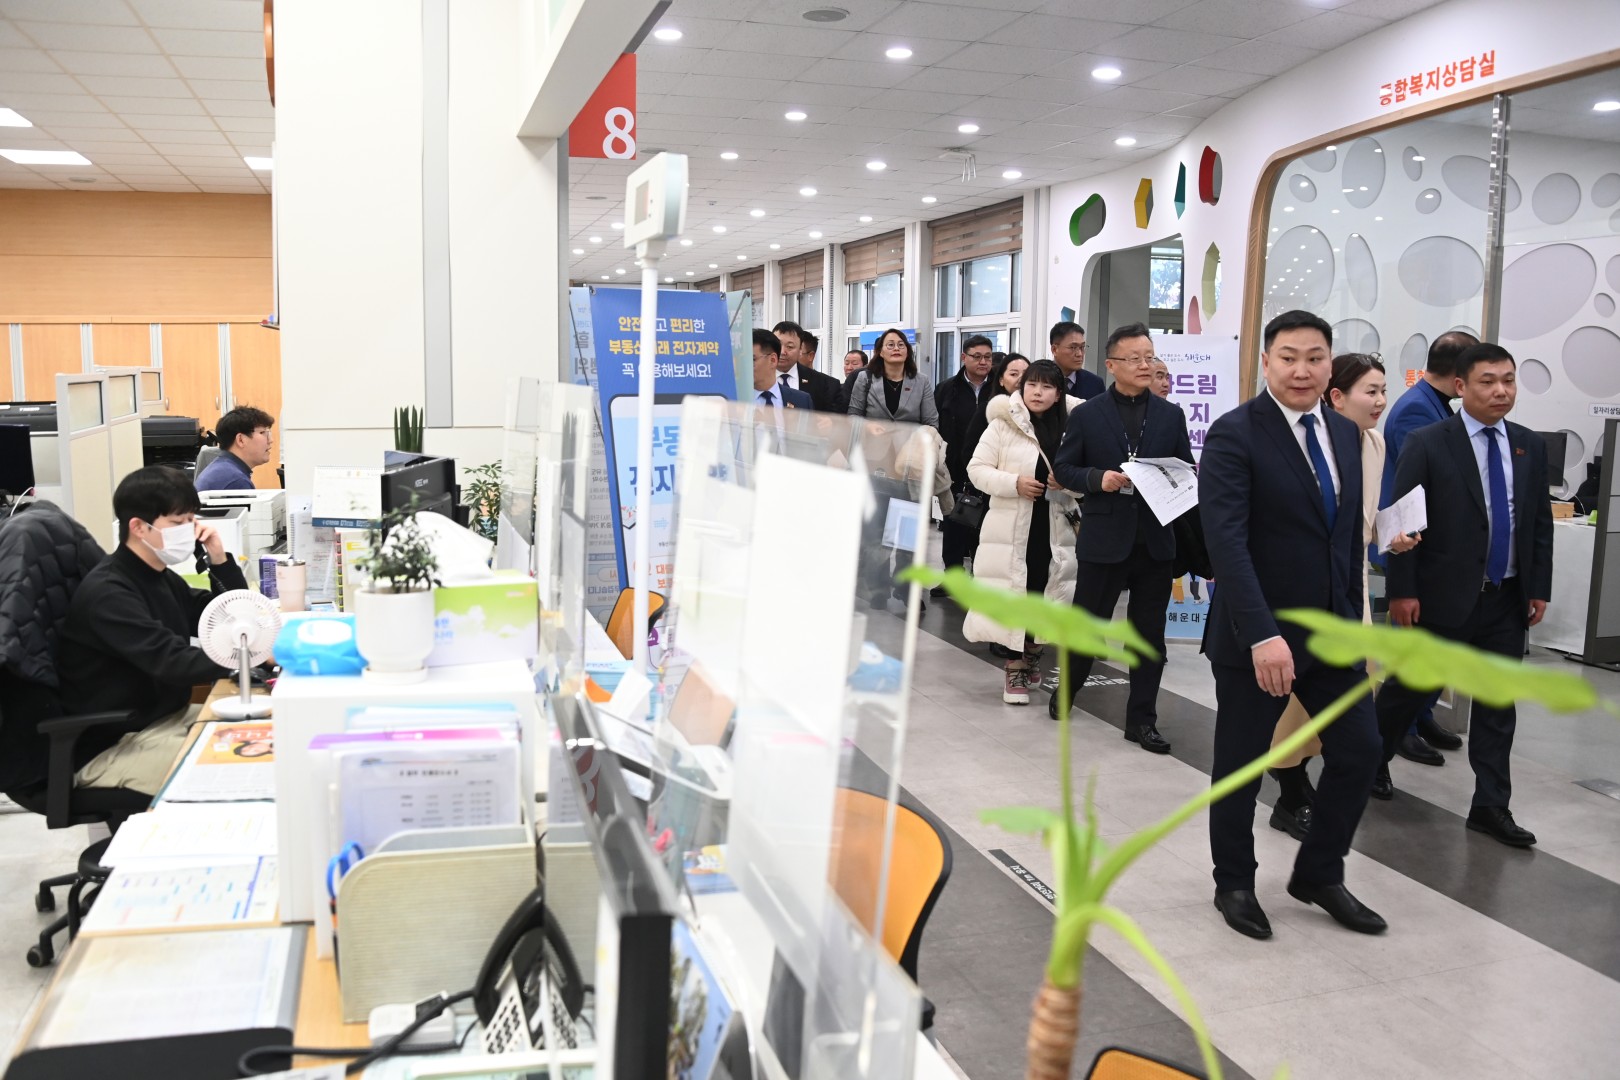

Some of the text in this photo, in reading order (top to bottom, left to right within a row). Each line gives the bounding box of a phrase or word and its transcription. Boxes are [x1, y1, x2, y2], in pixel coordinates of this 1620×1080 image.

[602, 106, 636, 160] 8
[618, 316, 706, 334] 안전고 편리한
[672, 341, 720, 356] 전자계약
[622, 363, 712, 379] 꼭 용해보세요!
